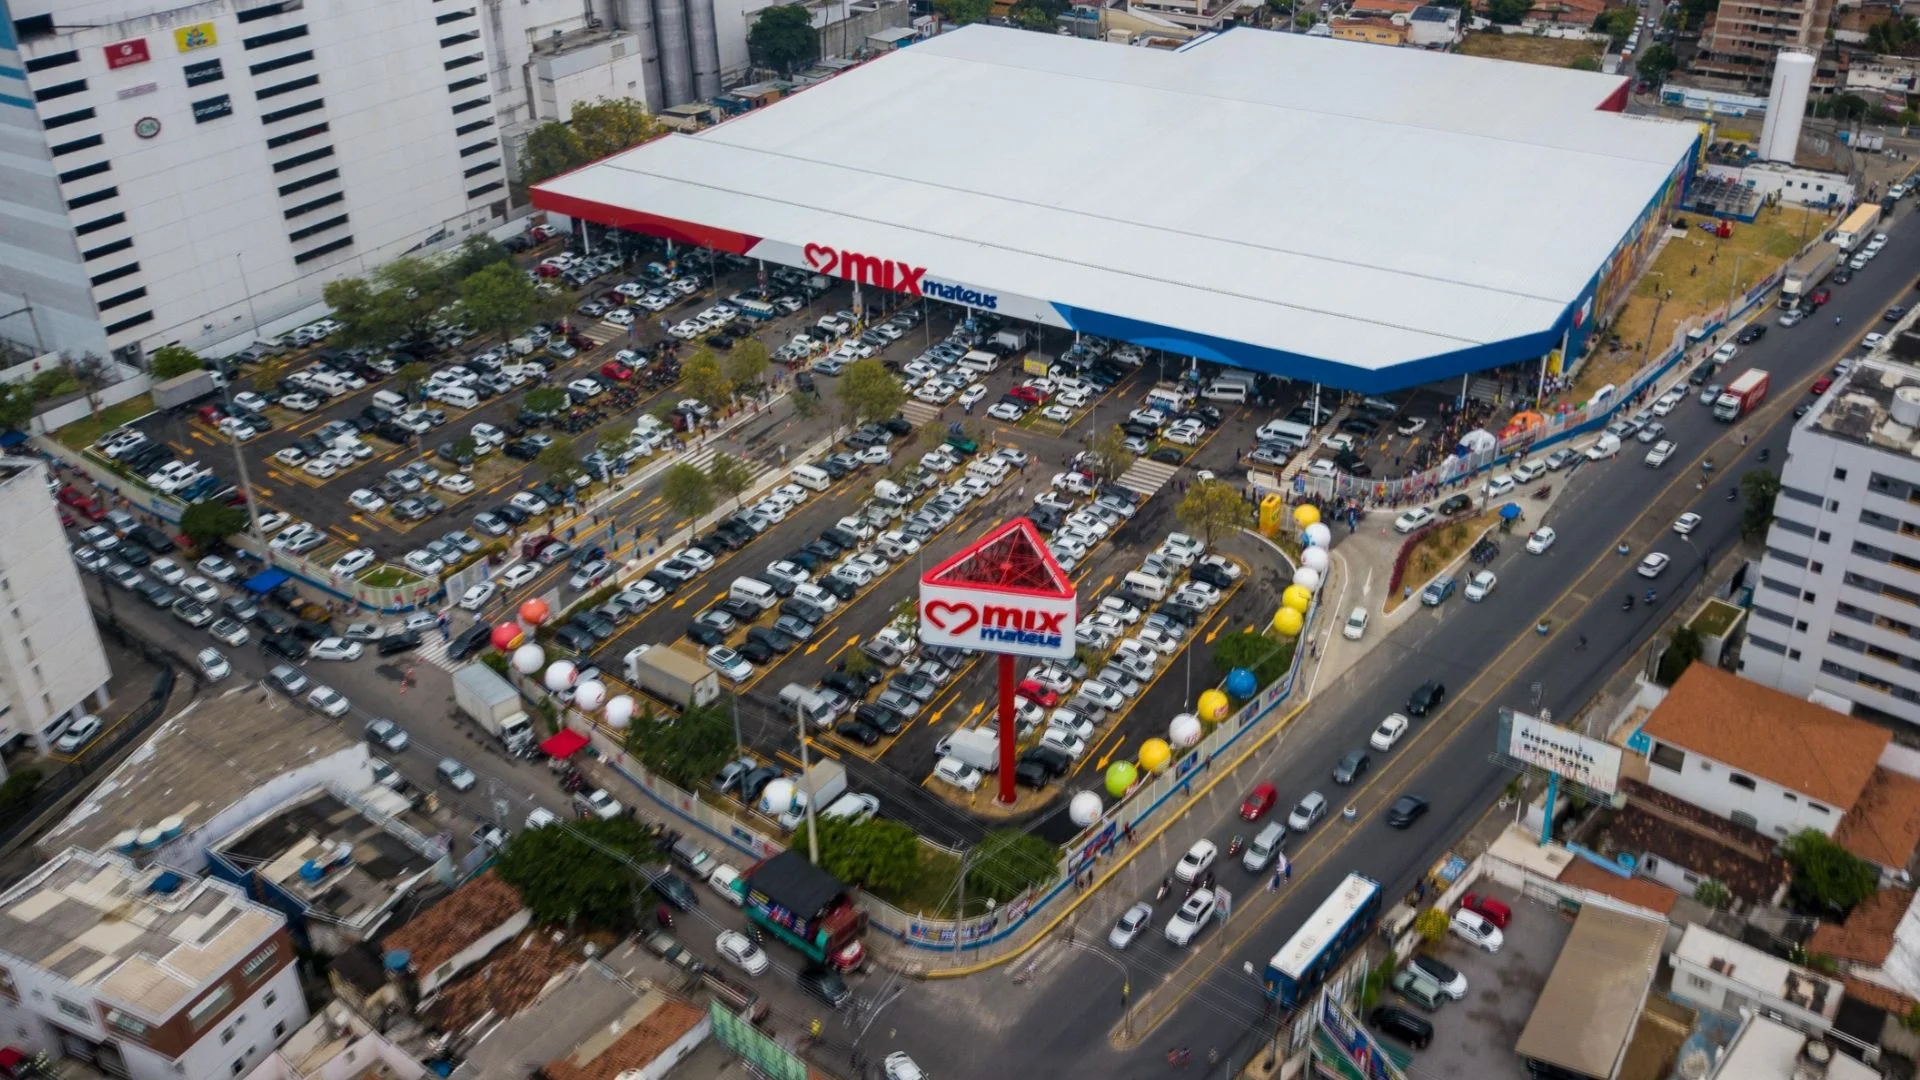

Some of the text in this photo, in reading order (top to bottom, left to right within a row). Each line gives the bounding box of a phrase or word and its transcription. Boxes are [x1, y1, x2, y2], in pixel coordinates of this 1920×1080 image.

[841, 250, 927, 297] mix
[923, 278, 997, 309] mateus
[982, 604, 1068, 634] mix
[980, 628, 1062, 648] mateus
